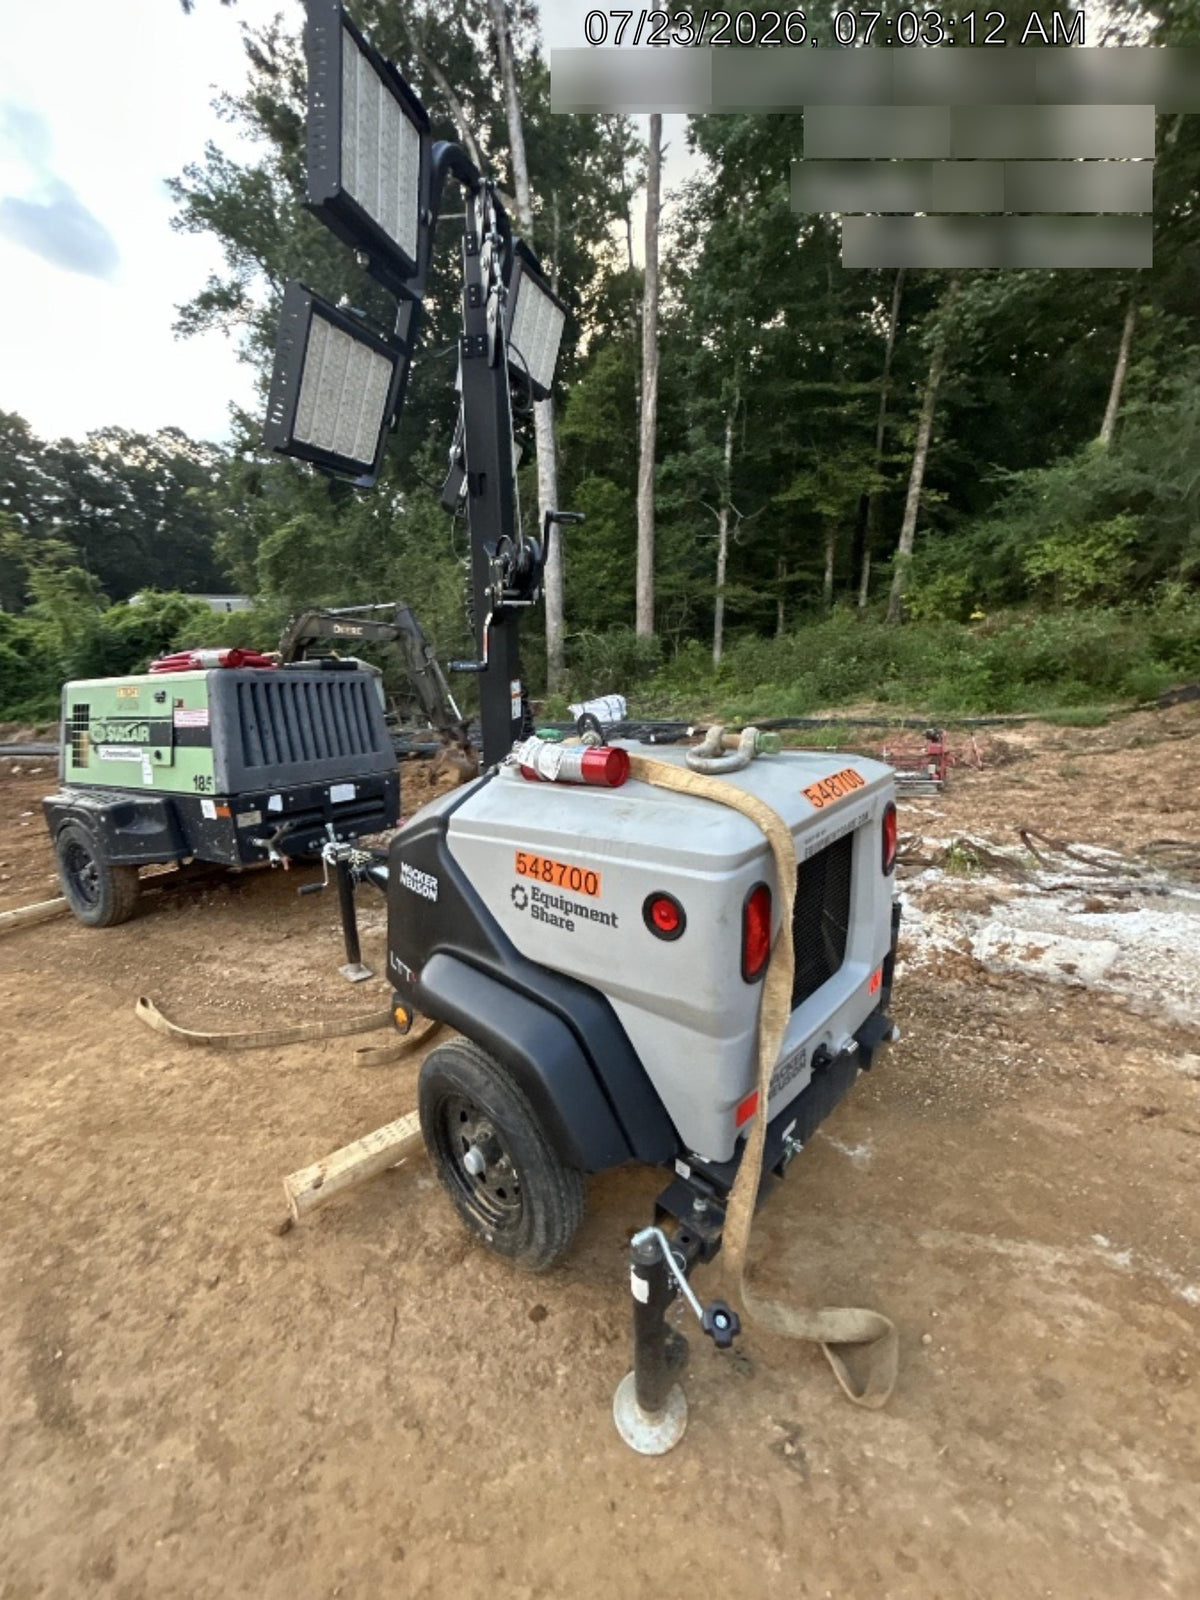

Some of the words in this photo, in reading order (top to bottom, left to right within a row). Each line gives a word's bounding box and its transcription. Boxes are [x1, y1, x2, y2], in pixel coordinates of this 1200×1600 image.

[803, 769, 865, 808] 548700
[516, 852, 599, 896] 548700
[530, 885, 620, 929] Equipment
[530, 904, 576, 933] Share
